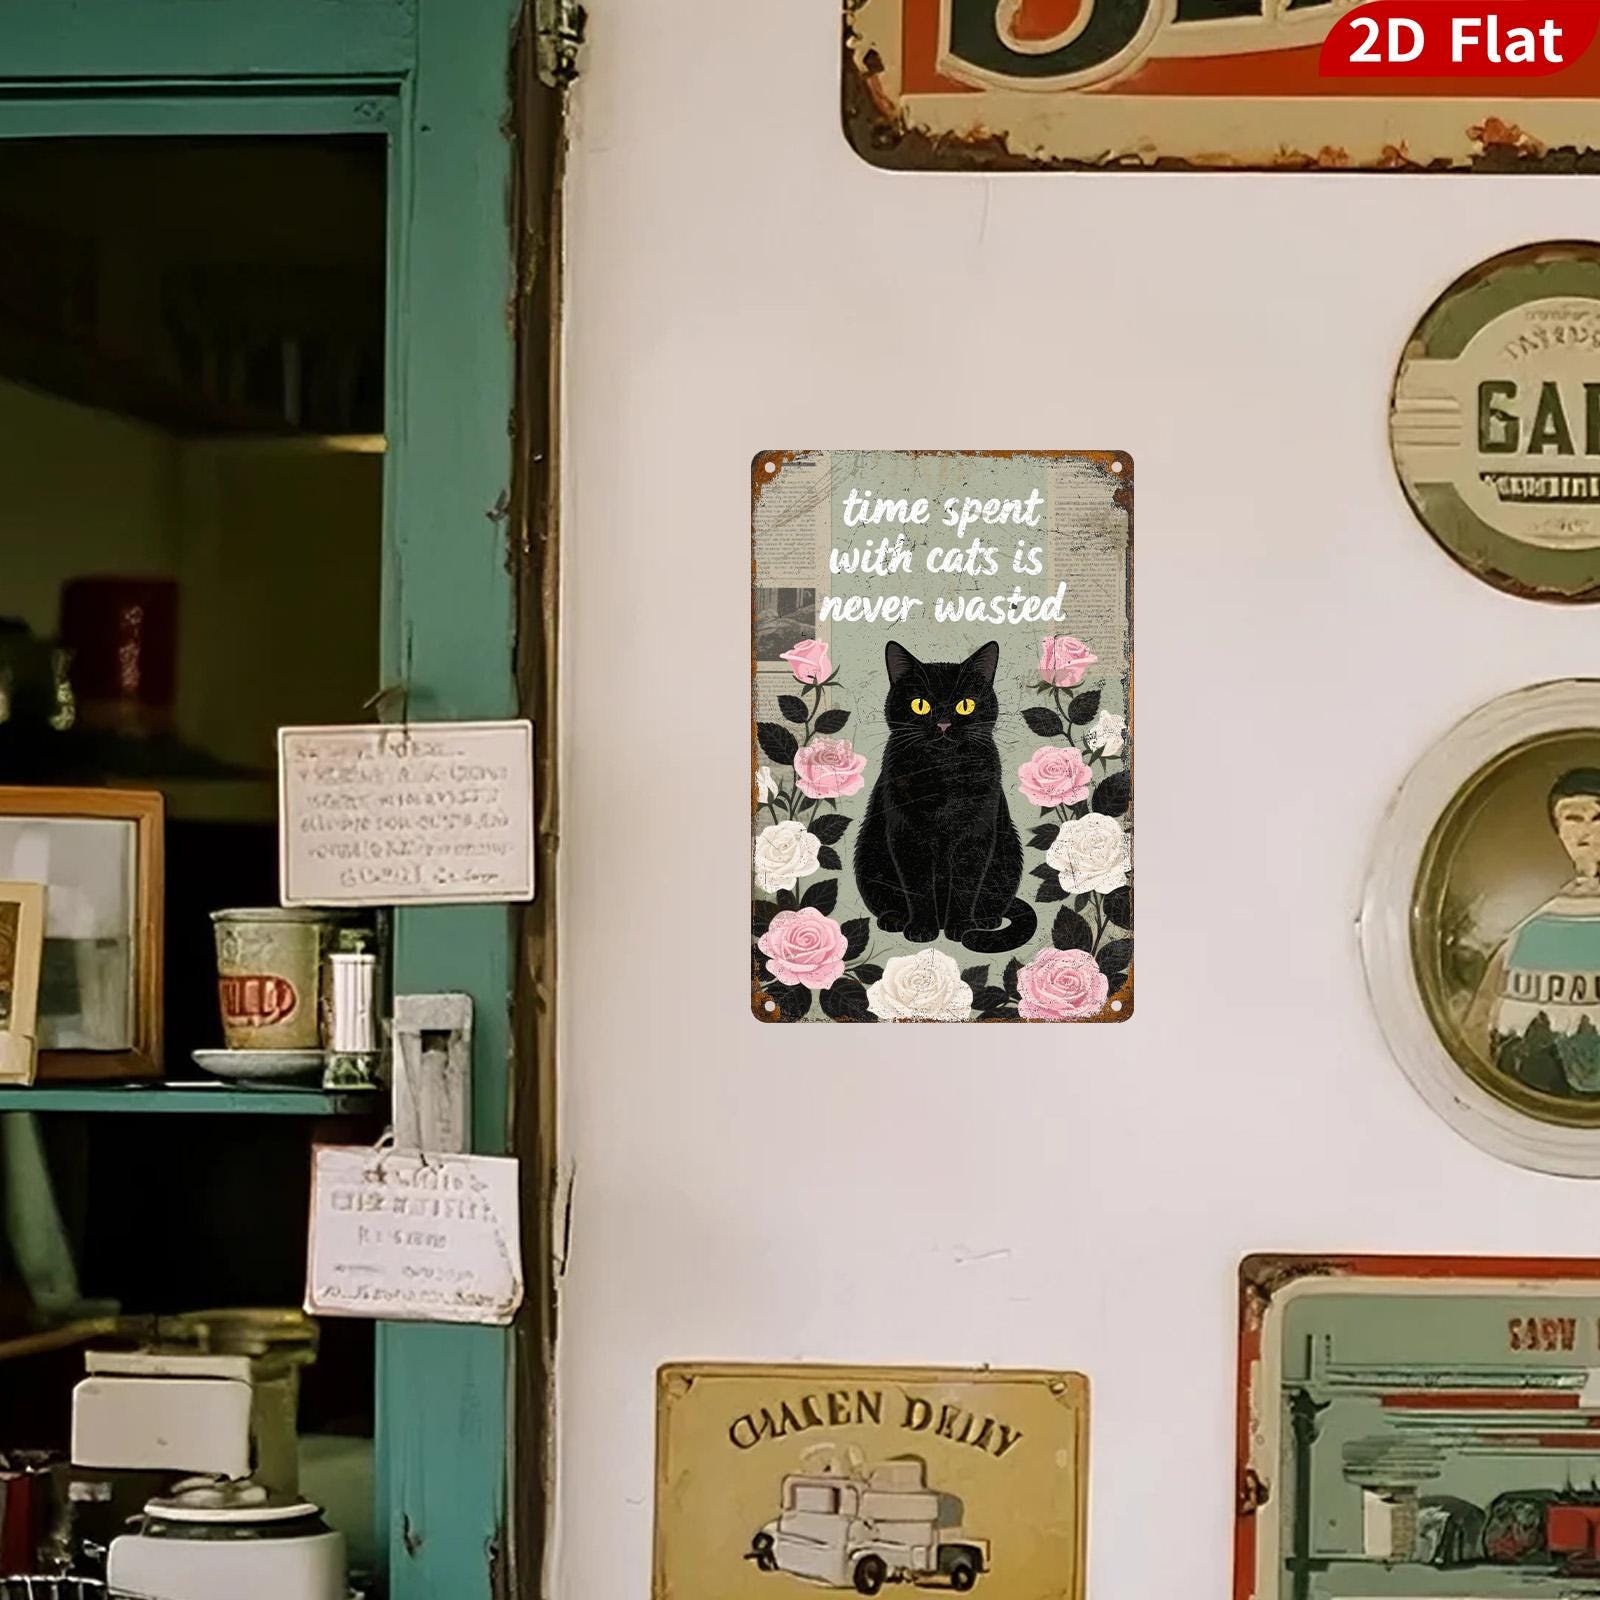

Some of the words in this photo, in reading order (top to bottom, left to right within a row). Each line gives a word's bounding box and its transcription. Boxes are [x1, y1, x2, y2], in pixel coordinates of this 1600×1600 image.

[842, 488, 931, 528] time
[941, 488, 1045, 538] spent
[829, 534, 913, 576] with
[926, 537, 1000, 576] cats
[1012, 540, 1044, 575] is
[819, 593, 924, 624] never
[934, 581, 1068, 625] wasted
